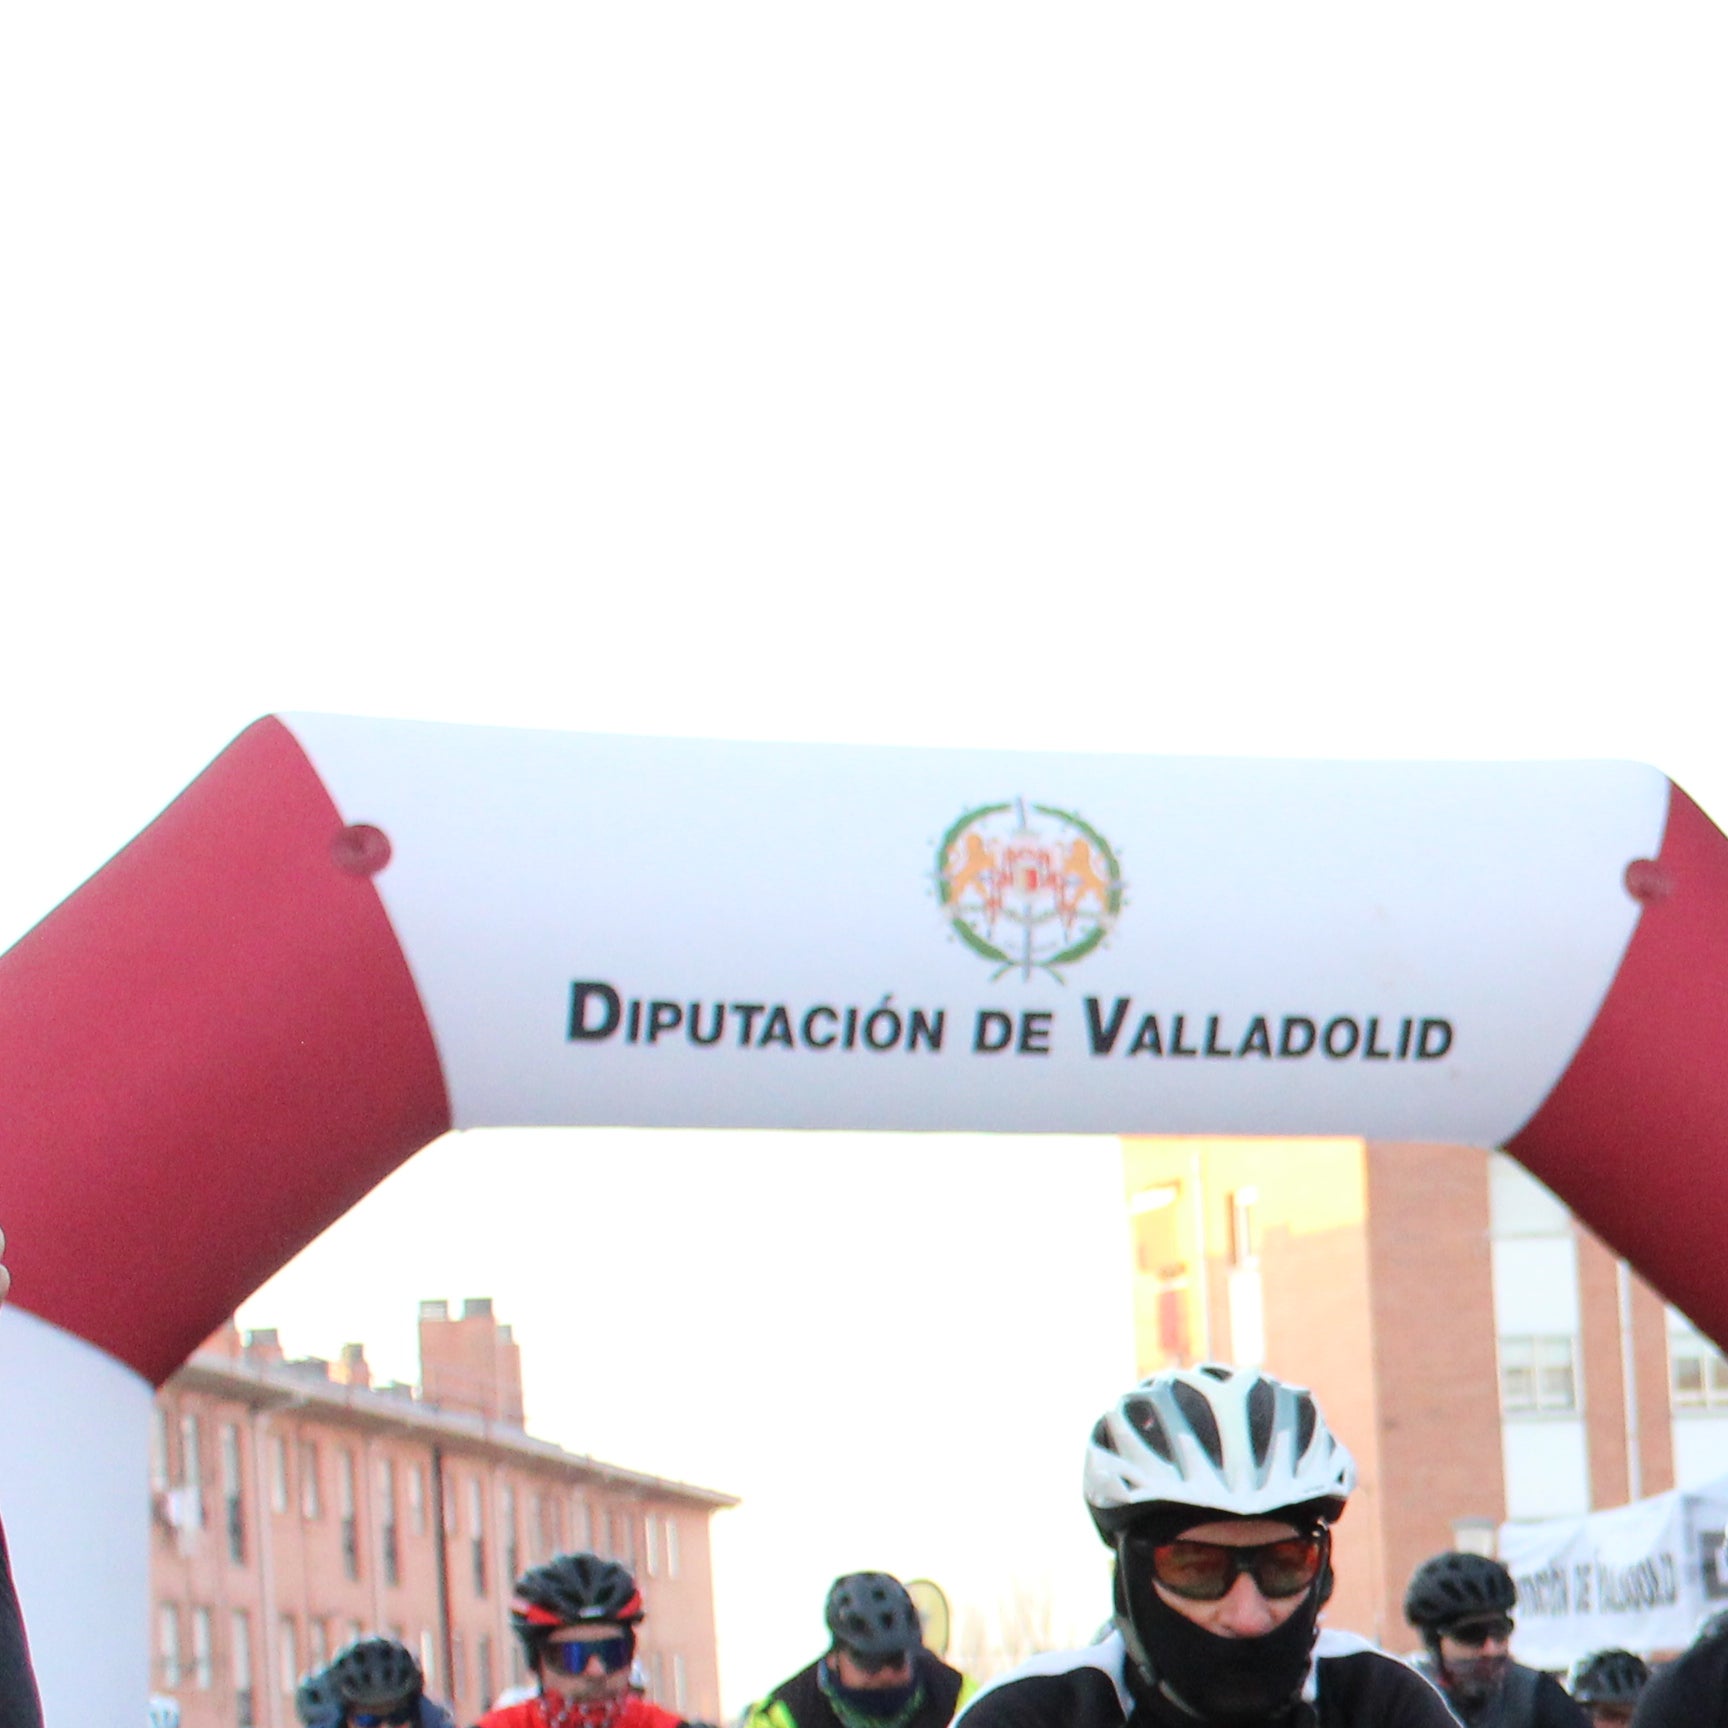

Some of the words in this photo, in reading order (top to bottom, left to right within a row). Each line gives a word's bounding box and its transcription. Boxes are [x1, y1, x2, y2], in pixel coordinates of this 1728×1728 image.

[566, 979, 944, 1053] DIPUTACIÓN
[974, 1009, 1052, 1056] DE
[1084, 997, 1454, 1062] VALLADOLID
